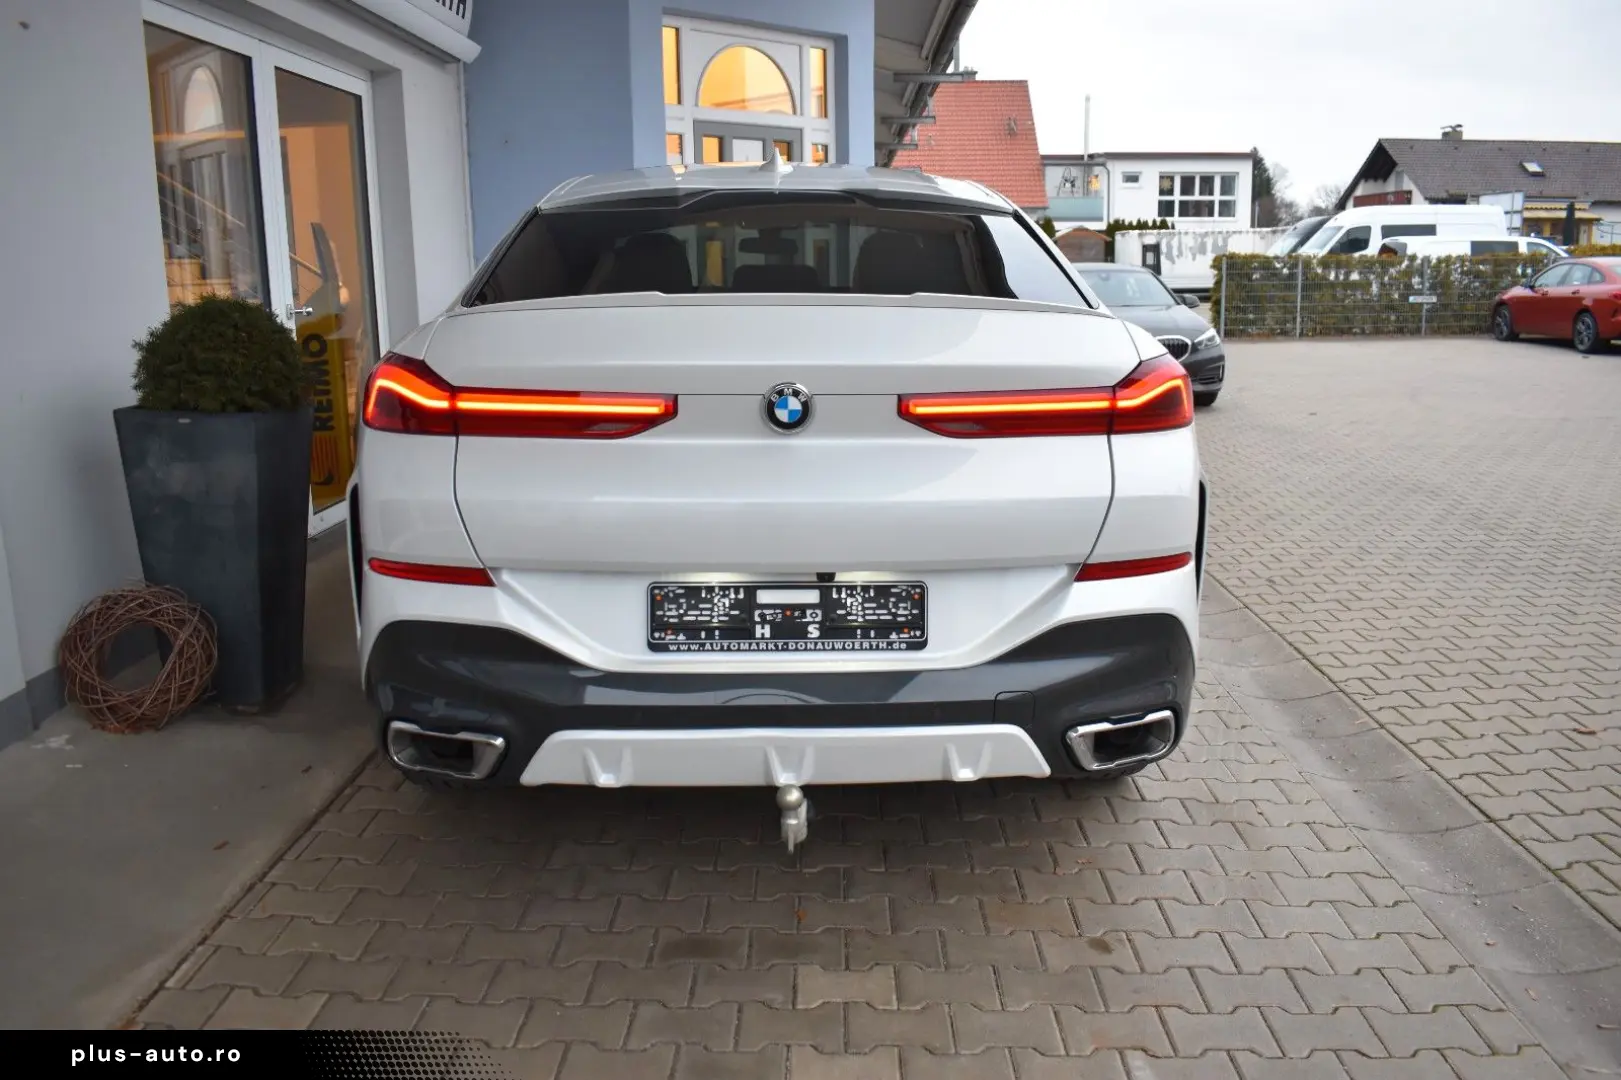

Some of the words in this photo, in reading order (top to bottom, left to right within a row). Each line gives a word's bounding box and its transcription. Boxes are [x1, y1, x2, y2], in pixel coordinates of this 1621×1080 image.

[302, 333, 335, 432] REIMO
[770, 388, 807, 402] BMW
[668, 641, 907, 651] www.AUTOMARKT-DONAUWOERTH.de
